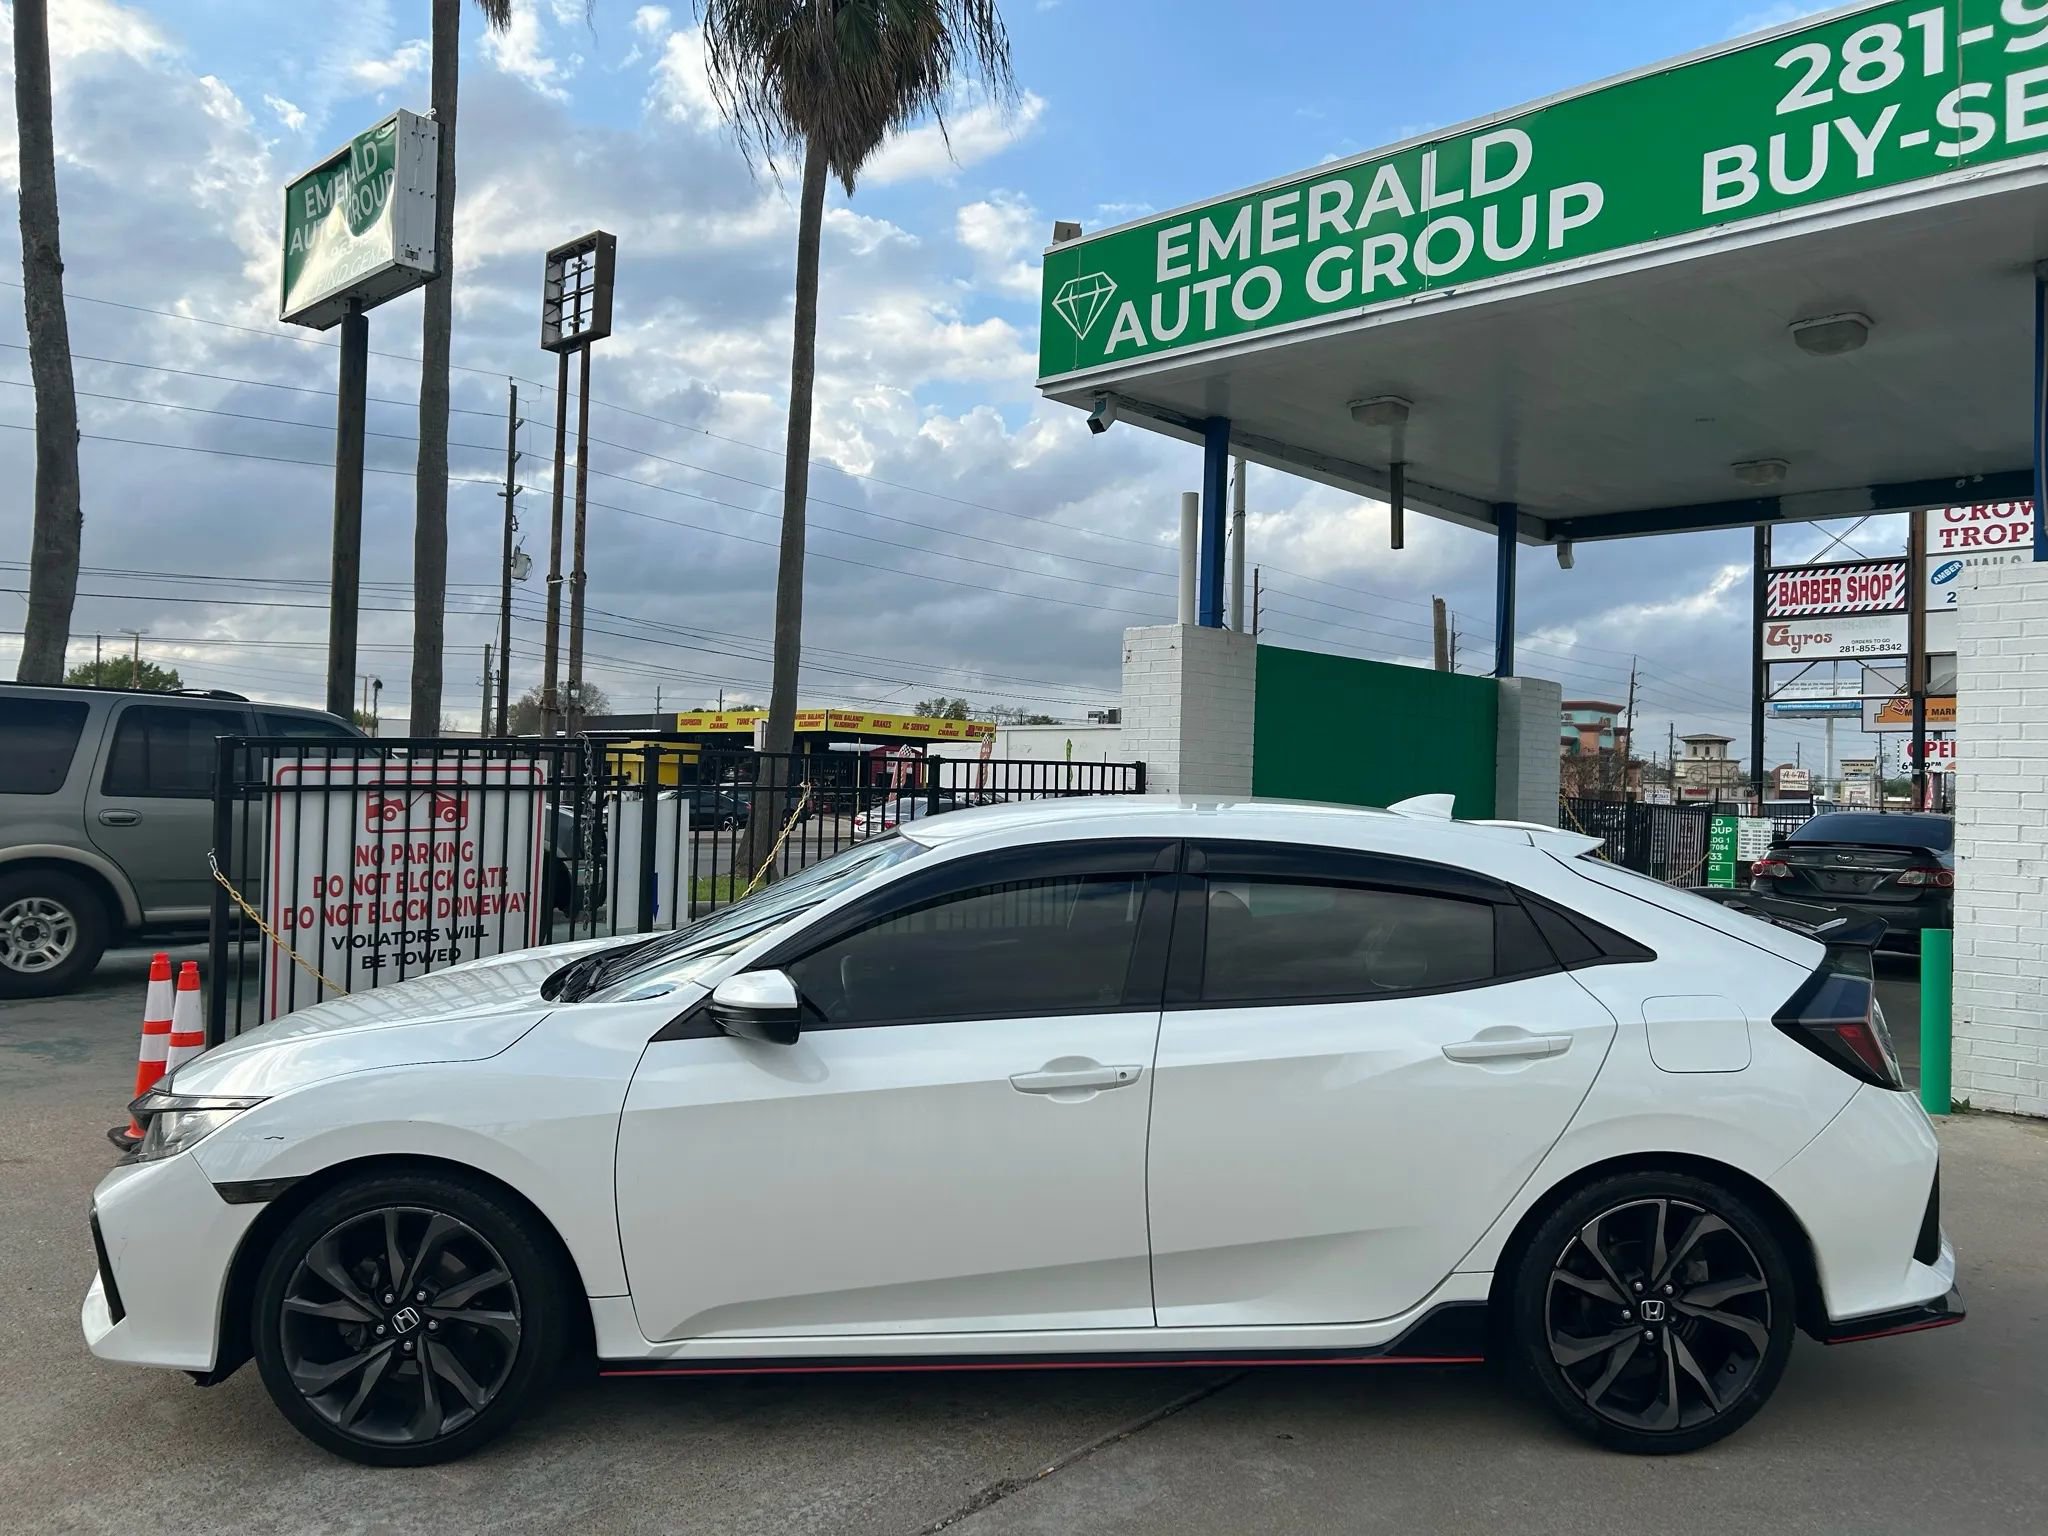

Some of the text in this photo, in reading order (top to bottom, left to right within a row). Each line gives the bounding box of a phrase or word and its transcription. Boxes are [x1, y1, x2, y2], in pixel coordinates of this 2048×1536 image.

[1155, 128, 1531, 283] EMERALD
[1103, 181, 1602, 354] AUTO GROUP
[1939, 522, 2034, 548] TROP
[1933, 561, 1962, 584] AMBER
[1779, 574, 1893, 607] BARBER SHOP
[1766, 624, 1833, 654] Gyros
[1839, 643, 1902, 653] 281-855-8342
[1892, 699, 1909, 713] LA
[873, 719, 892, 728] BRAKES
[902, 722, 930, 731] AC SERVICE
[937, 729, 959, 737] CHANGE
[355, 840, 474, 867] NO PARKING
[312, 867, 509, 899] DO NOT BLOCK GATE
[283, 891, 531, 931] DO NOT BLOCK DRIVEWAY
[331, 924, 489, 950] VIOLATORS WILL
[361, 947, 462, 970] BE TOWED
